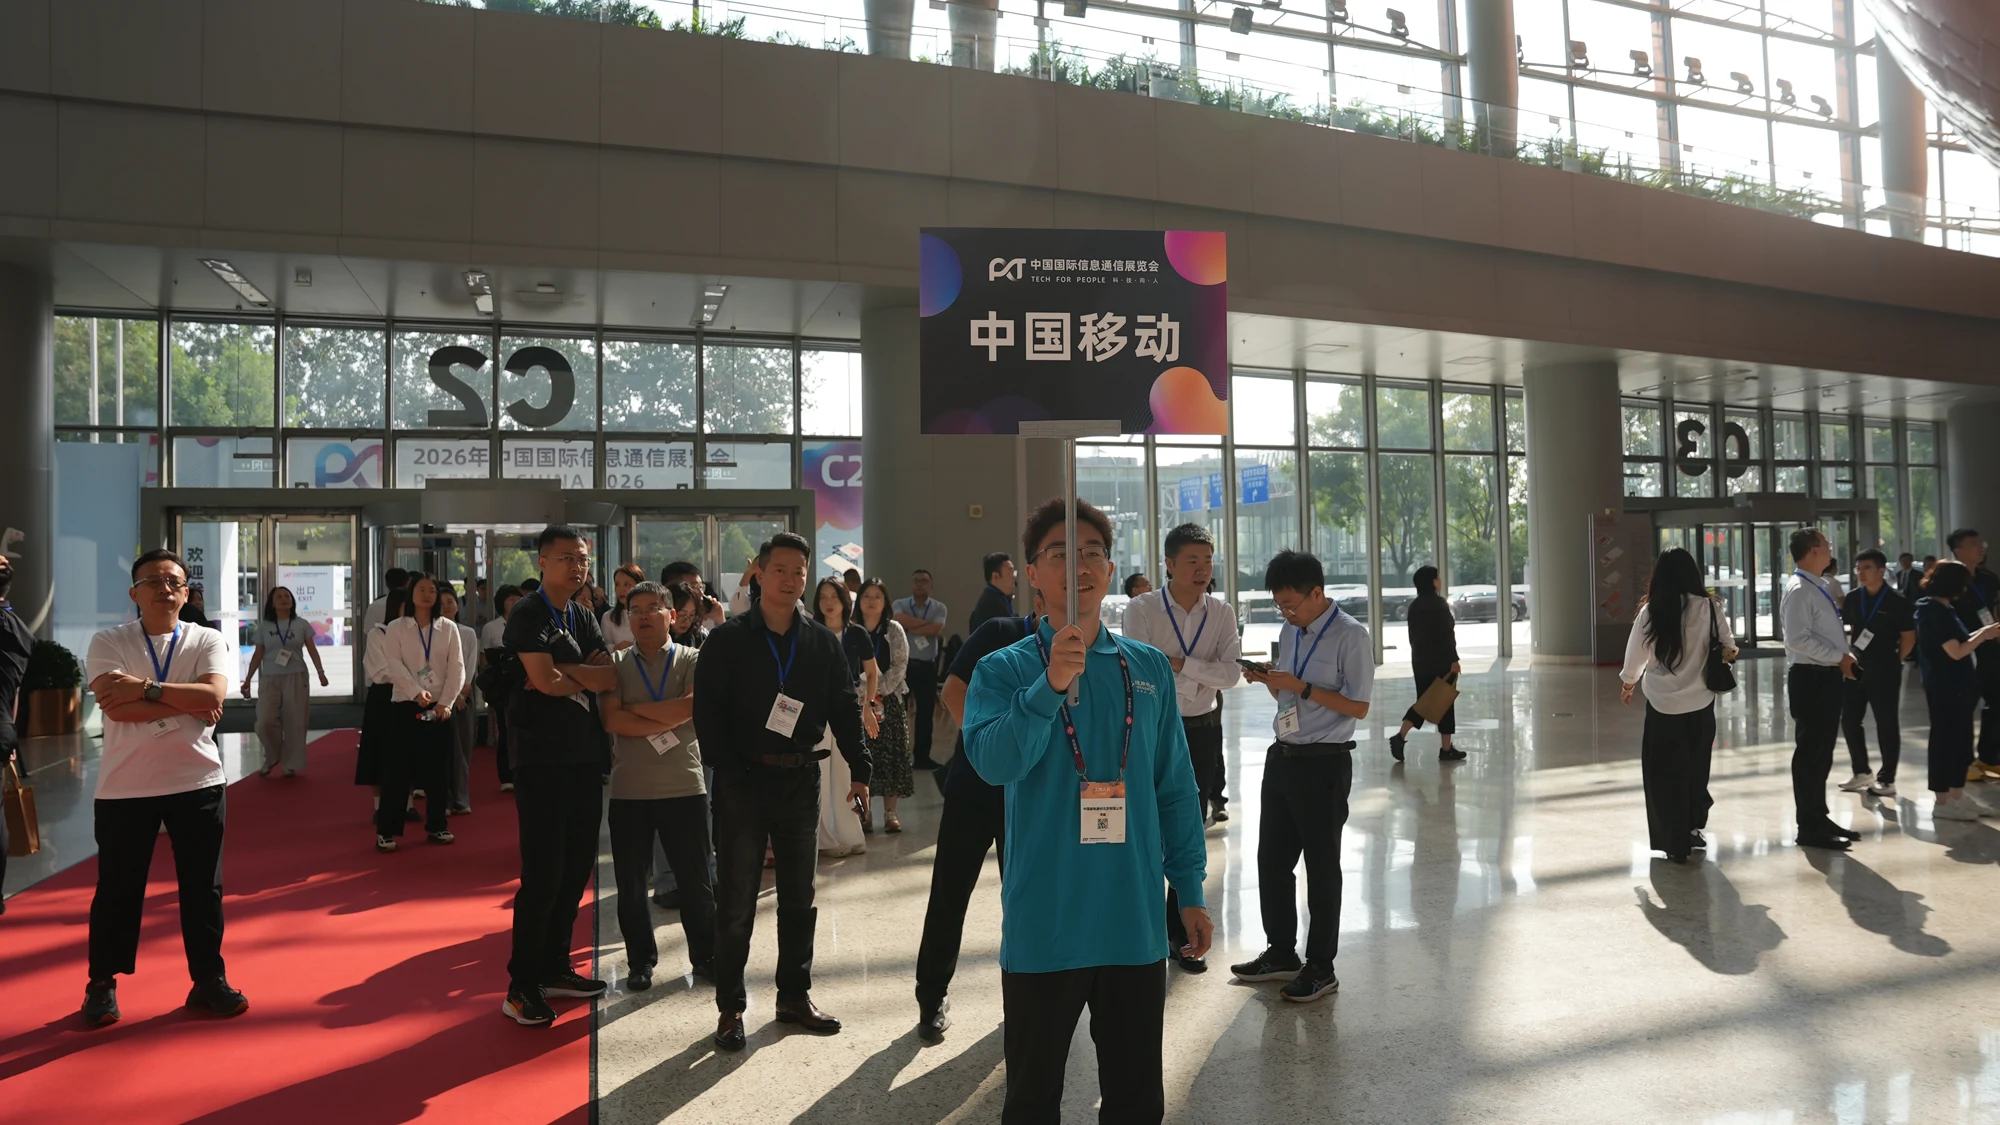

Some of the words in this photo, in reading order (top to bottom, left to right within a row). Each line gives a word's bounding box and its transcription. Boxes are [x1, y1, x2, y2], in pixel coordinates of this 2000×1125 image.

[1030, 258, 1160, 272] 中国国际信息通信展览会
[1031, 275, 1050, 283] TECH
[1076, 276, 1106, 284] PEOPLE
[970, 311, 1180, 363] 中国移动
[413, 446, 730, 468] 2026年国国际信息通信展会
[821, 454, 863, 488] C2
[607, 474, 644, 489] 026
[296, 586, 315, 595] 出口
